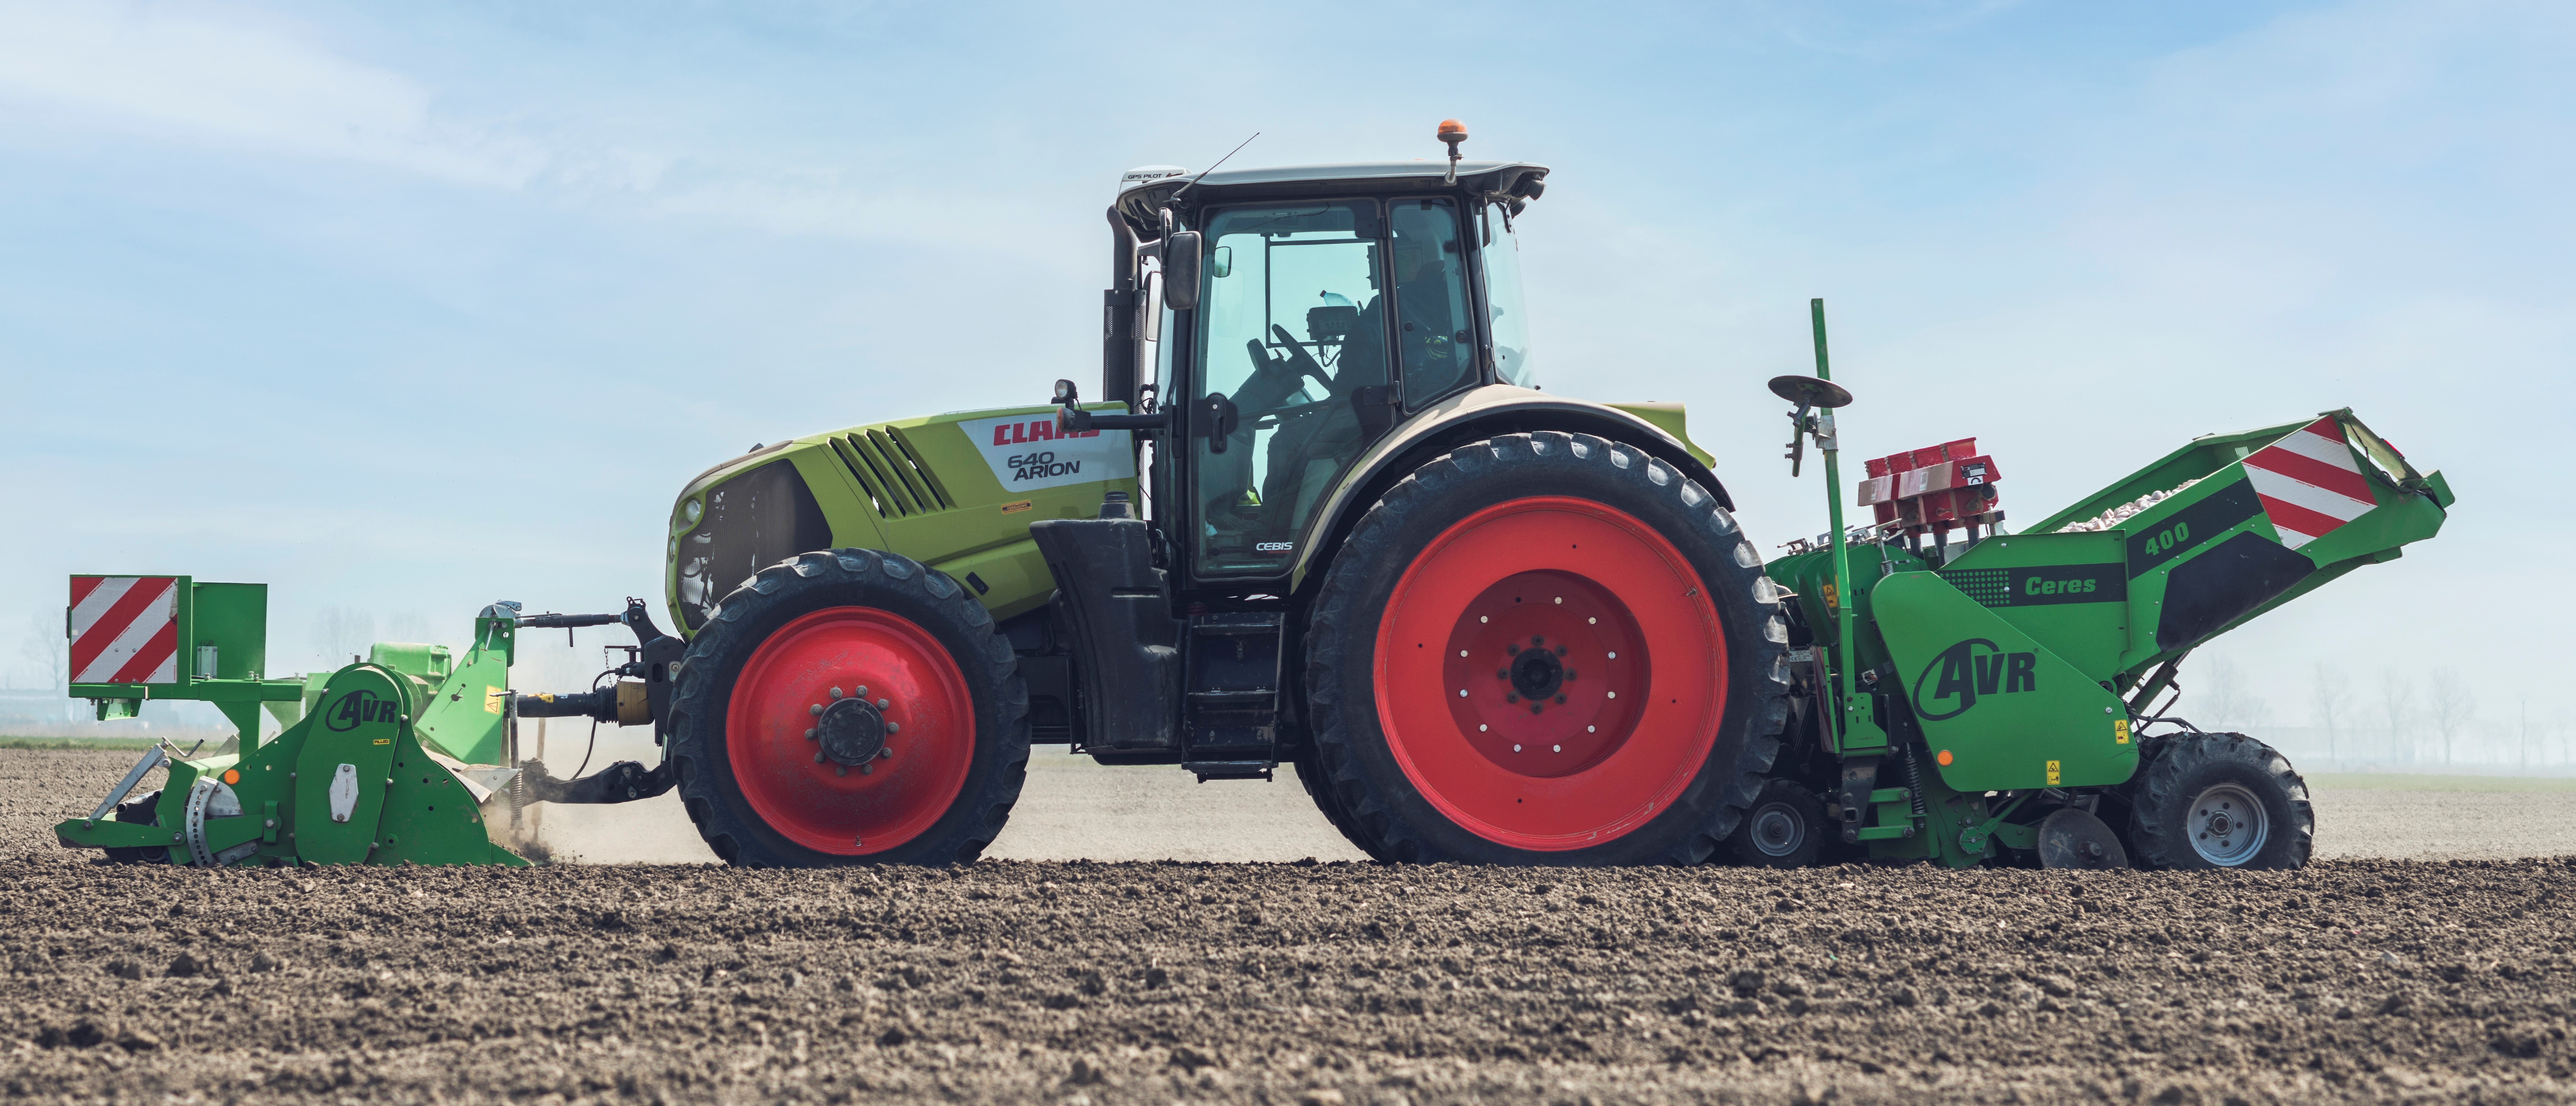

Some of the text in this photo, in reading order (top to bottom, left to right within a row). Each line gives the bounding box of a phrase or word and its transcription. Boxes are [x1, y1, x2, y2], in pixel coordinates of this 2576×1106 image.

[1008, 452, 1054, 469] 640
[1013, 460, 1080, 481] ARION
[1256, 542, 1293, 550] CEBIS
[2145, 522, 2189, 556] 400
[2025, 576, 2096, 595] Ceres
[325, 690, 397, 732] AVR
